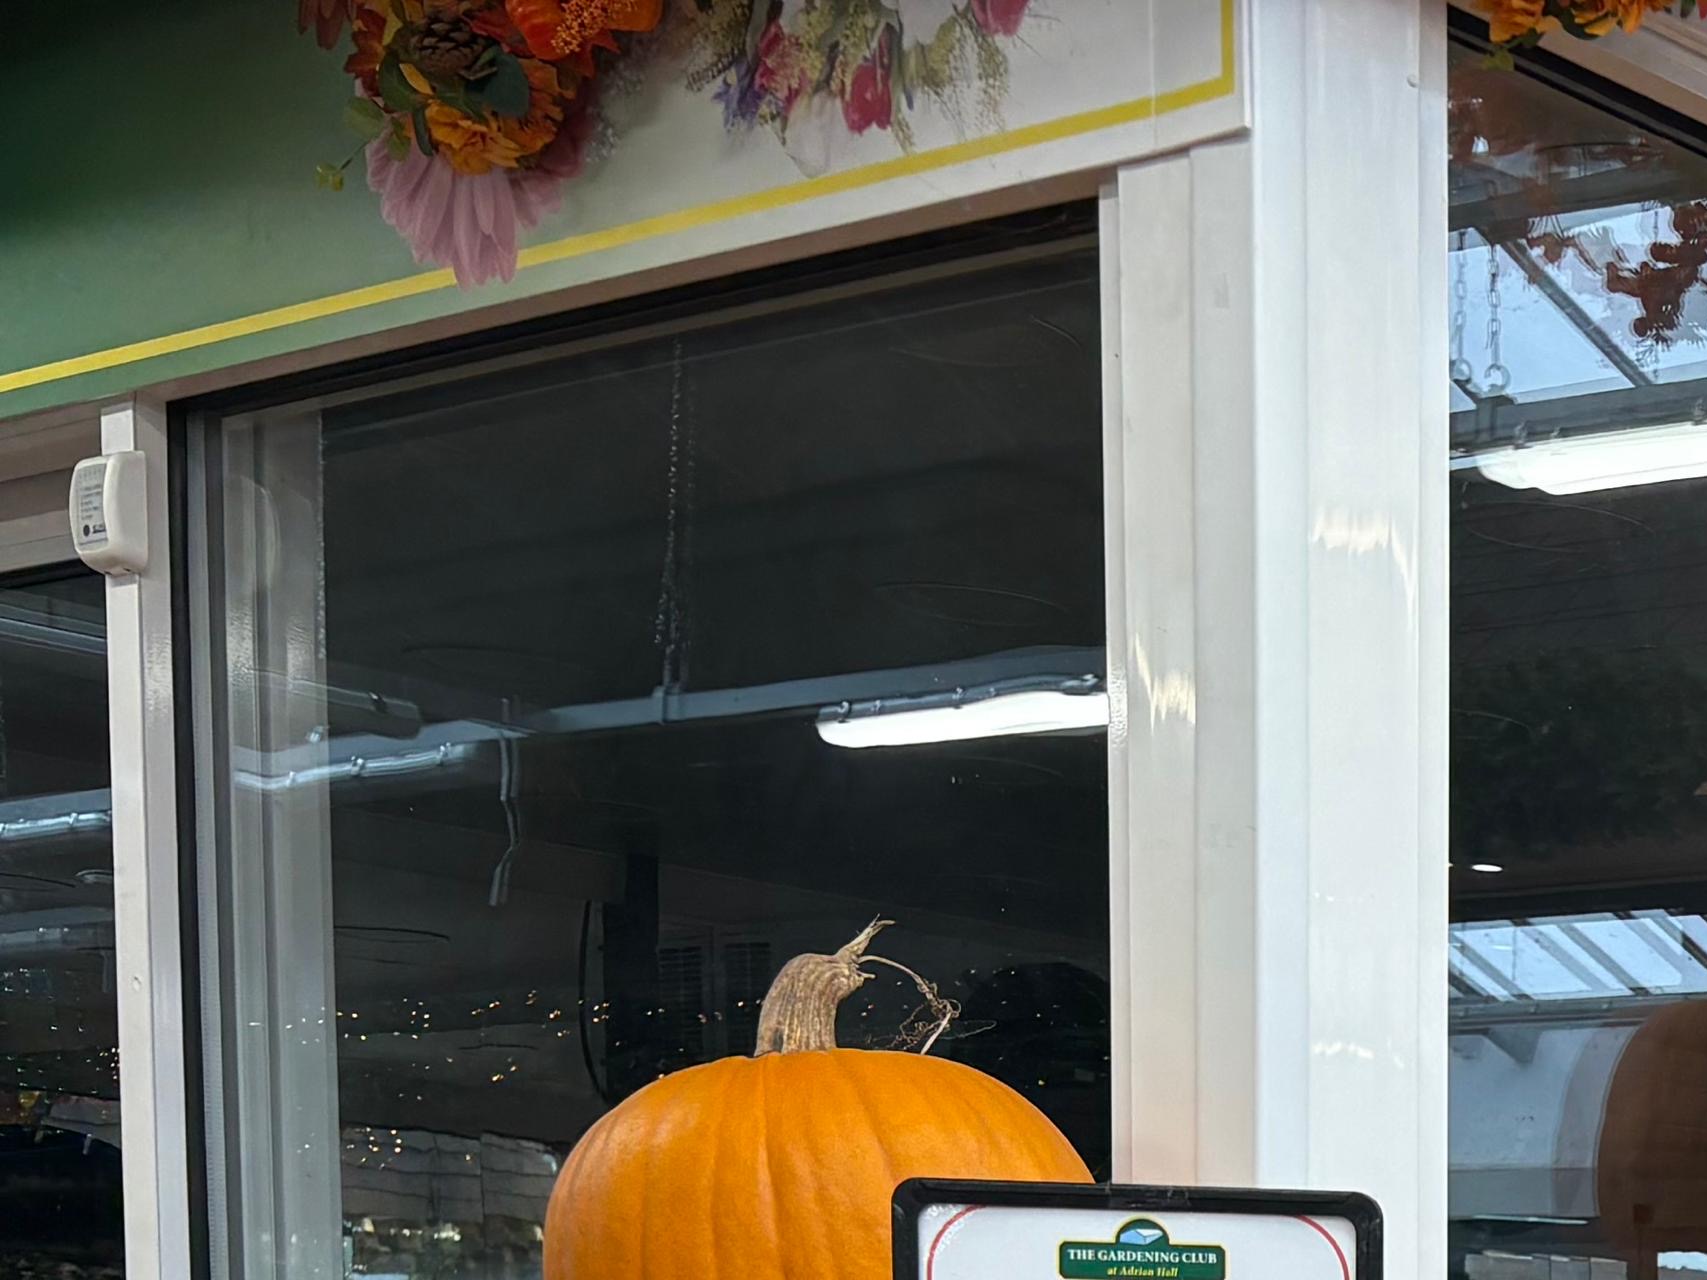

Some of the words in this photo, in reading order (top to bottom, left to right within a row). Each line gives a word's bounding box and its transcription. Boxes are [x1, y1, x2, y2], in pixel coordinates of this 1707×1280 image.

[1067, 1249, 1096, 1260] THE
[1097, 1250, 1180, 1263] GARDENING
[1181, 1252, 1217, 1264] CLUB
[1119, 1266, 1154, 1276] Adrian
